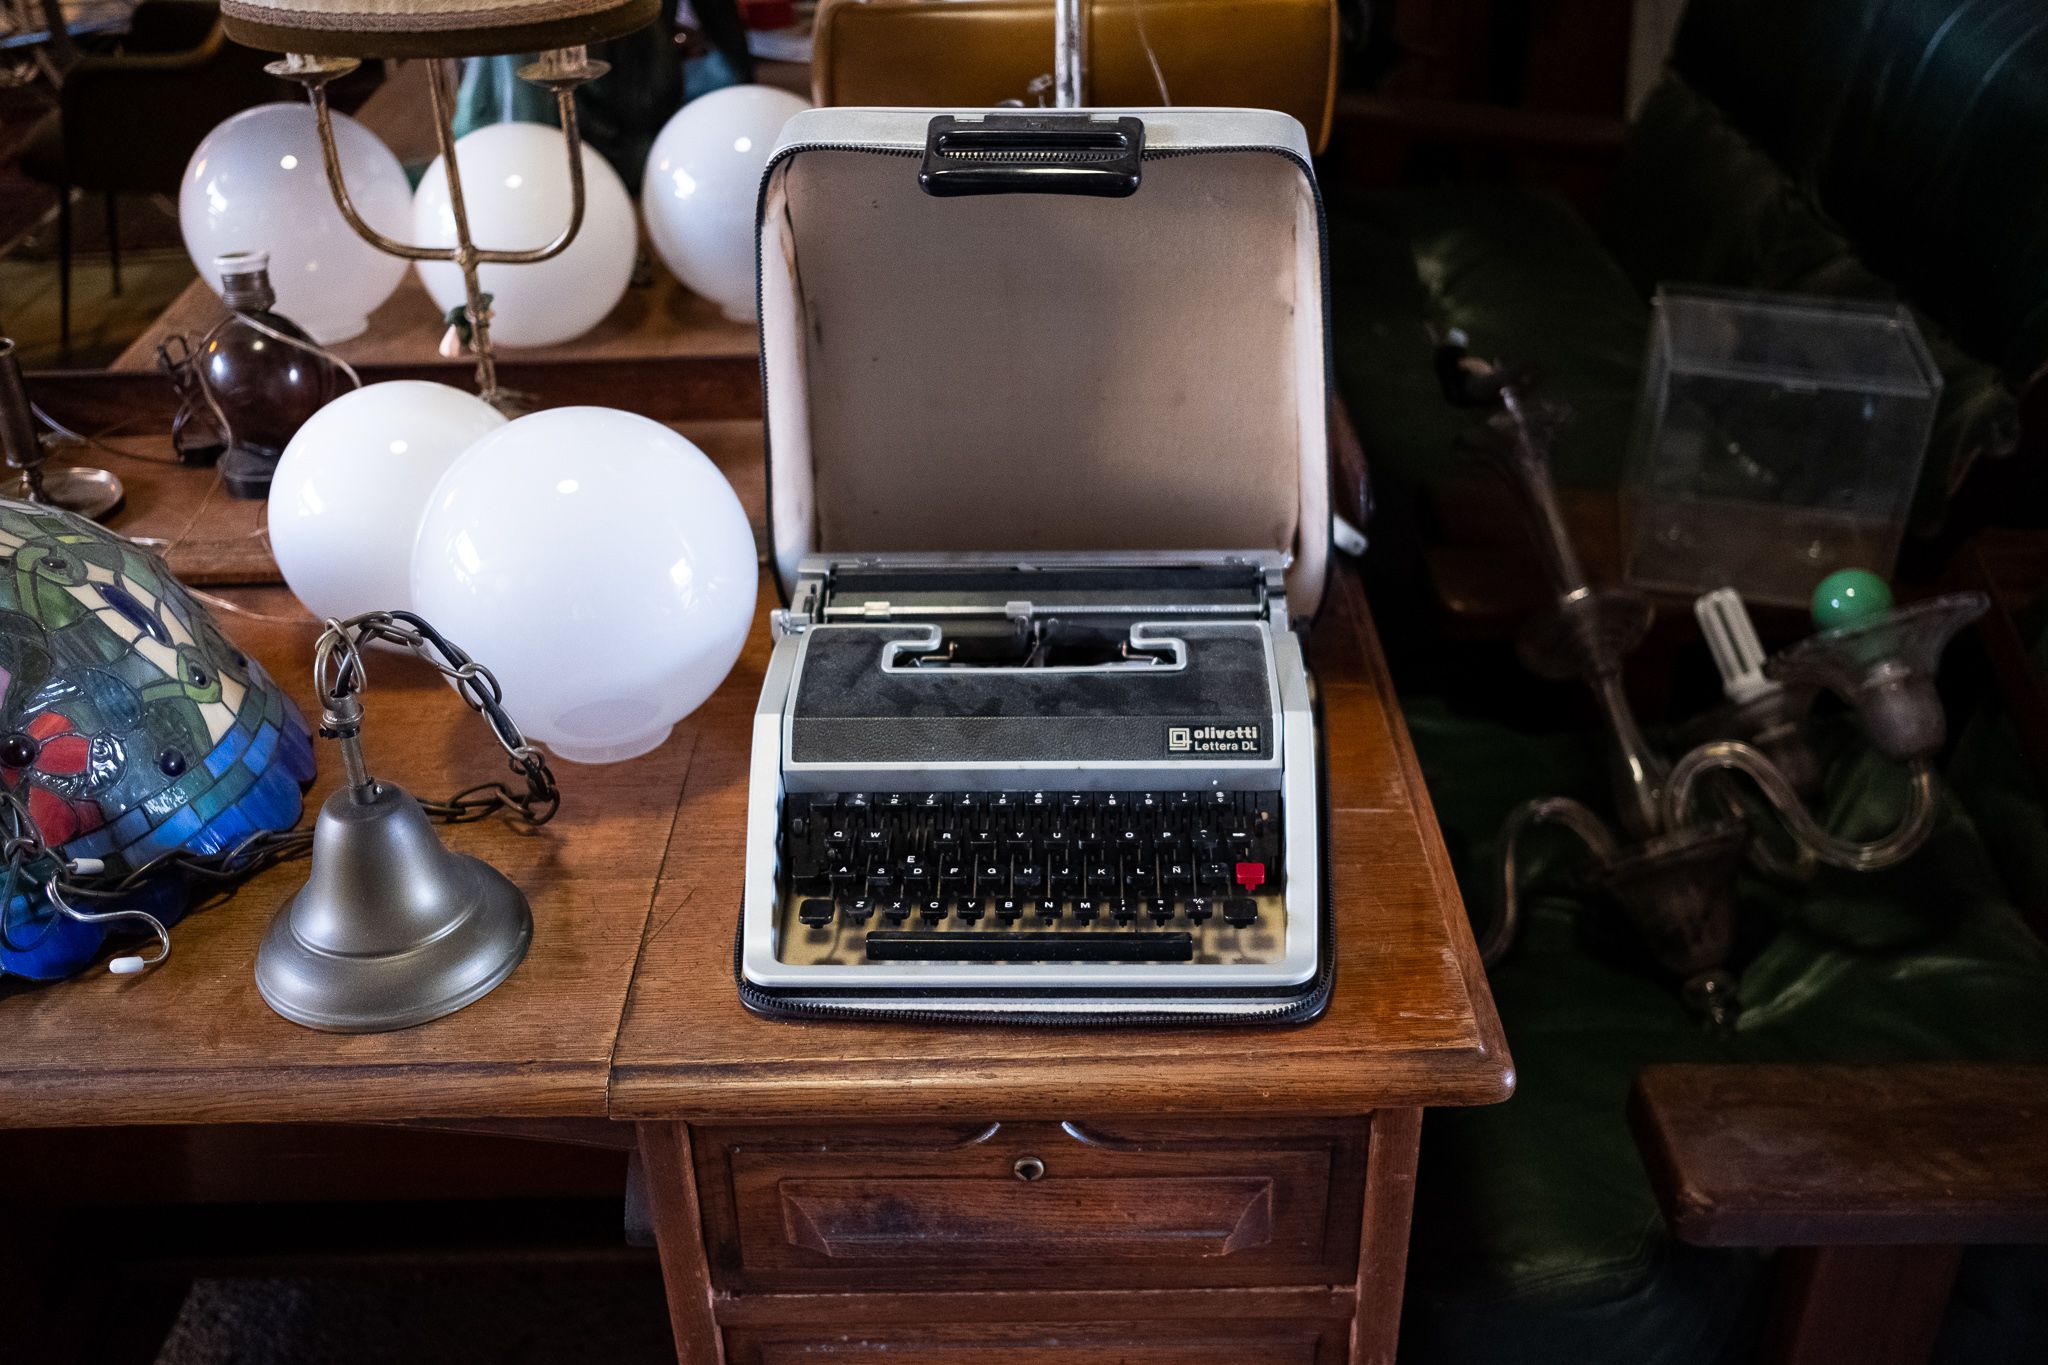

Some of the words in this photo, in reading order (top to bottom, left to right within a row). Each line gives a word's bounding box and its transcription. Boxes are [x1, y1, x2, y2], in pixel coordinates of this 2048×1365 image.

[1194, 726, 1258, 739] olivetti
[1194, 741, 1238, 750] Lettera
[1242, 741, 1258, 750] DL
